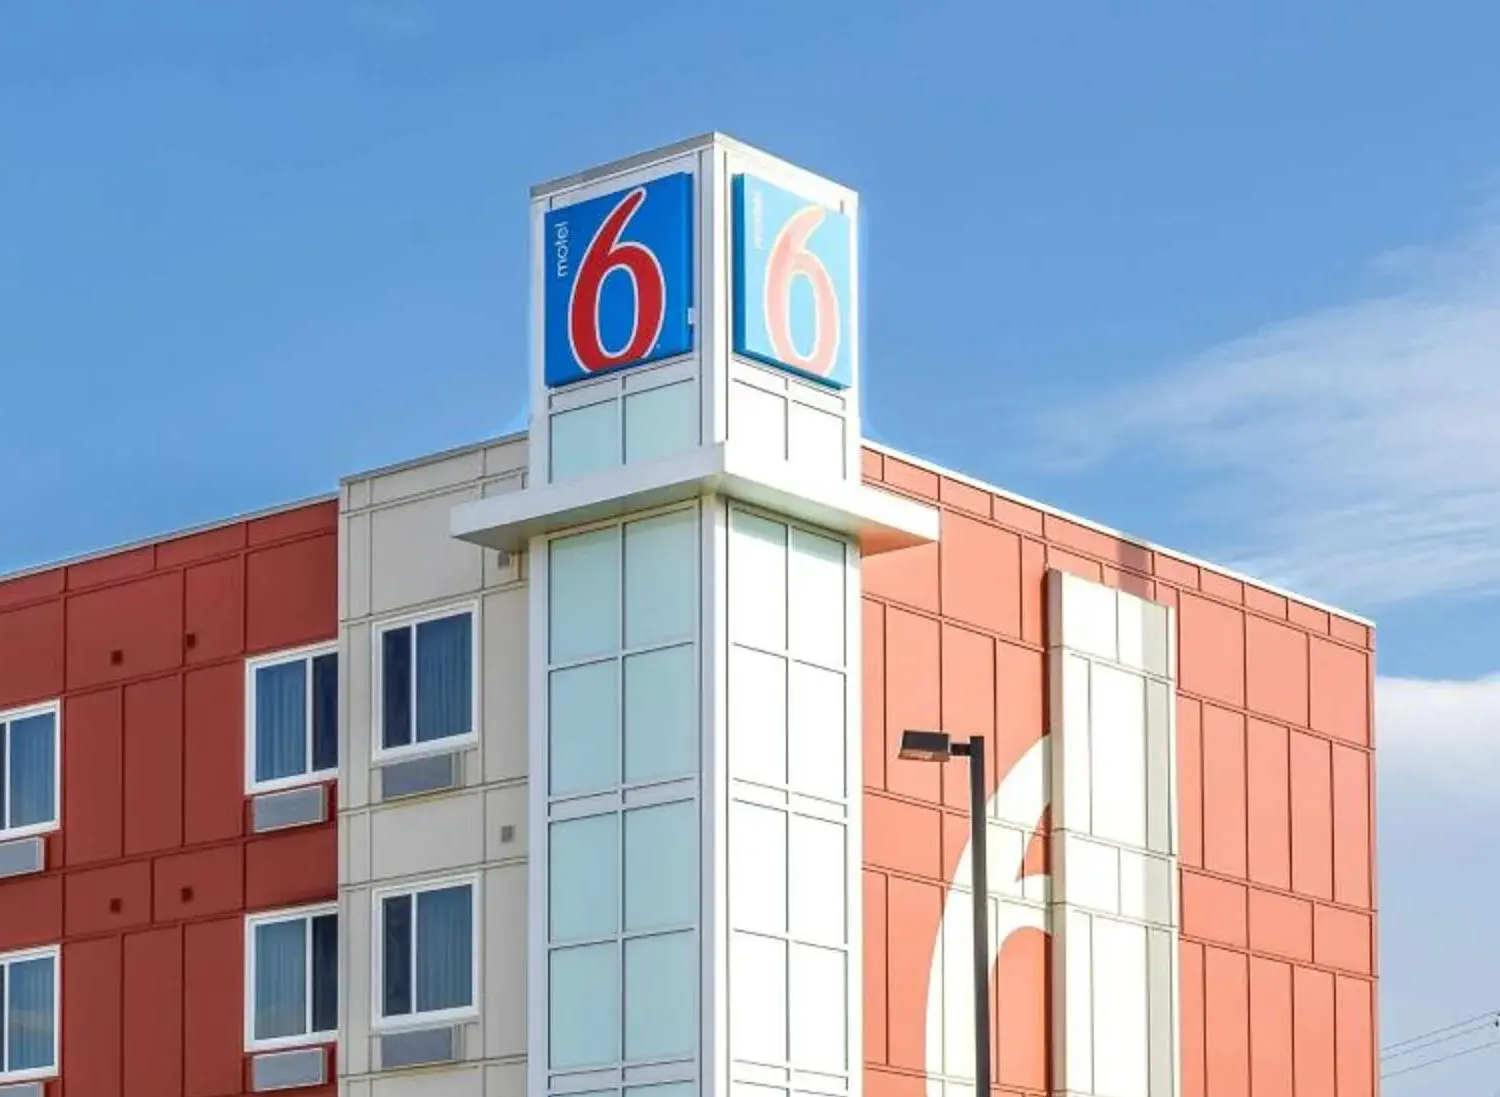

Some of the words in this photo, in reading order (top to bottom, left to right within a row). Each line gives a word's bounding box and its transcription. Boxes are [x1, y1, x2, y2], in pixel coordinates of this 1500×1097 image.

[554, 220, 569, 277] motel
[568, 187, 665, 373] 6
[764, 205, 840, 377] 6
